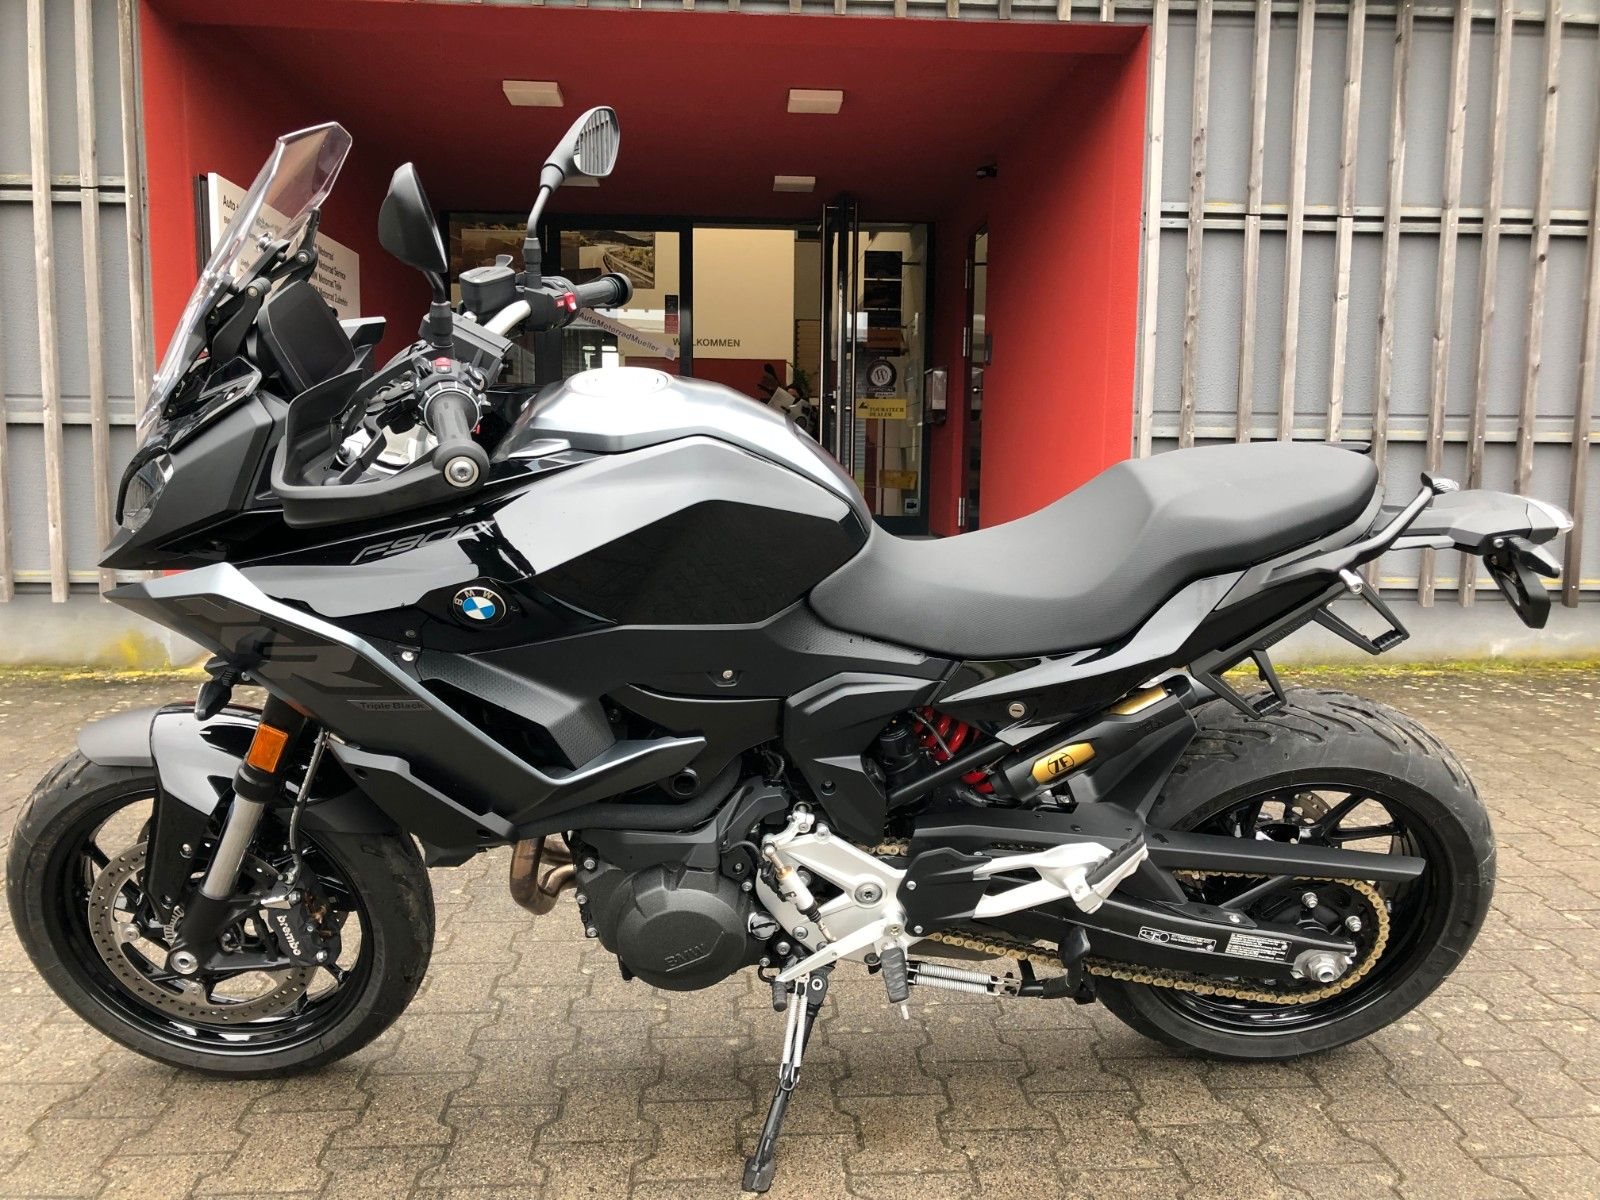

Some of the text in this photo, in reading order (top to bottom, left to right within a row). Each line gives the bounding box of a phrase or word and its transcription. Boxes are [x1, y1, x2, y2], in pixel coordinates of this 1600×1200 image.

[222, 195, 236, 211] Auto
[579, 312, 660, 352] AutoMotorradMueller
[672, 337, 741, 347] WKOMMEN
[454, 589, 494, 606] BMW
[360, 702, 424, 710] Triple Black
[1048, 755, 1074, 774] ZF
[276, 914, 302, 956] brembo
[664, 943, 705, 968] BMW
